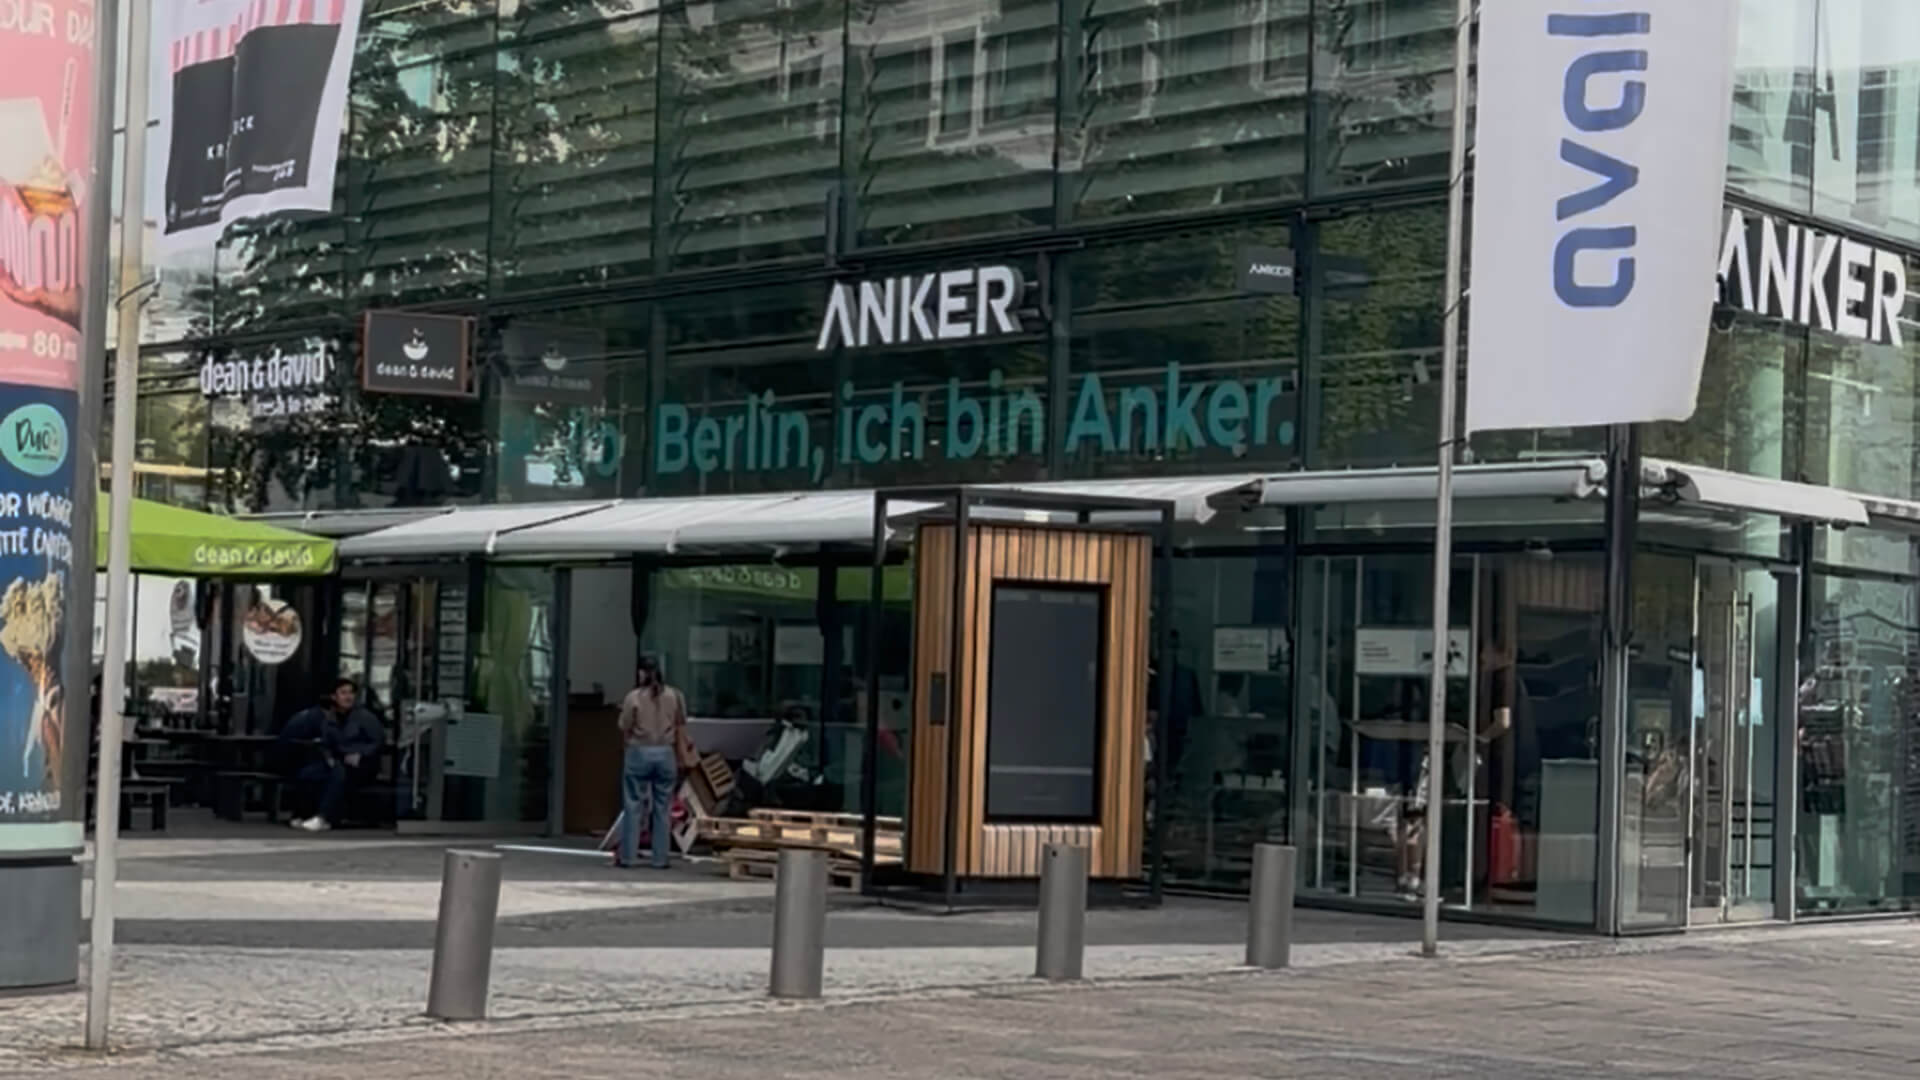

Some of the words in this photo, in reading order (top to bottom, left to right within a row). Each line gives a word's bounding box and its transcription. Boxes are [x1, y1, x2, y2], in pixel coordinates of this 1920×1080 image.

[1249, 263, 1293, 277] ANKER
[1714, 208, 1906, 346] ANKER
[816, 264, 1018, 350] ANKER
[200, 353, 248, 394] dean
[267, 343, 326, 389] david
[376, 361, 408, 376] dean
[420, 364, 455, 380] david
[656, 388, 825, 484] Berlin,
[840, 379, 926, 464] ich
[946, 368, 1045, 460] bin
[1064, 360, 1295, 452] Anker.
[195, 543, 242, 564] dean
[260, 545, 313, 566] david
